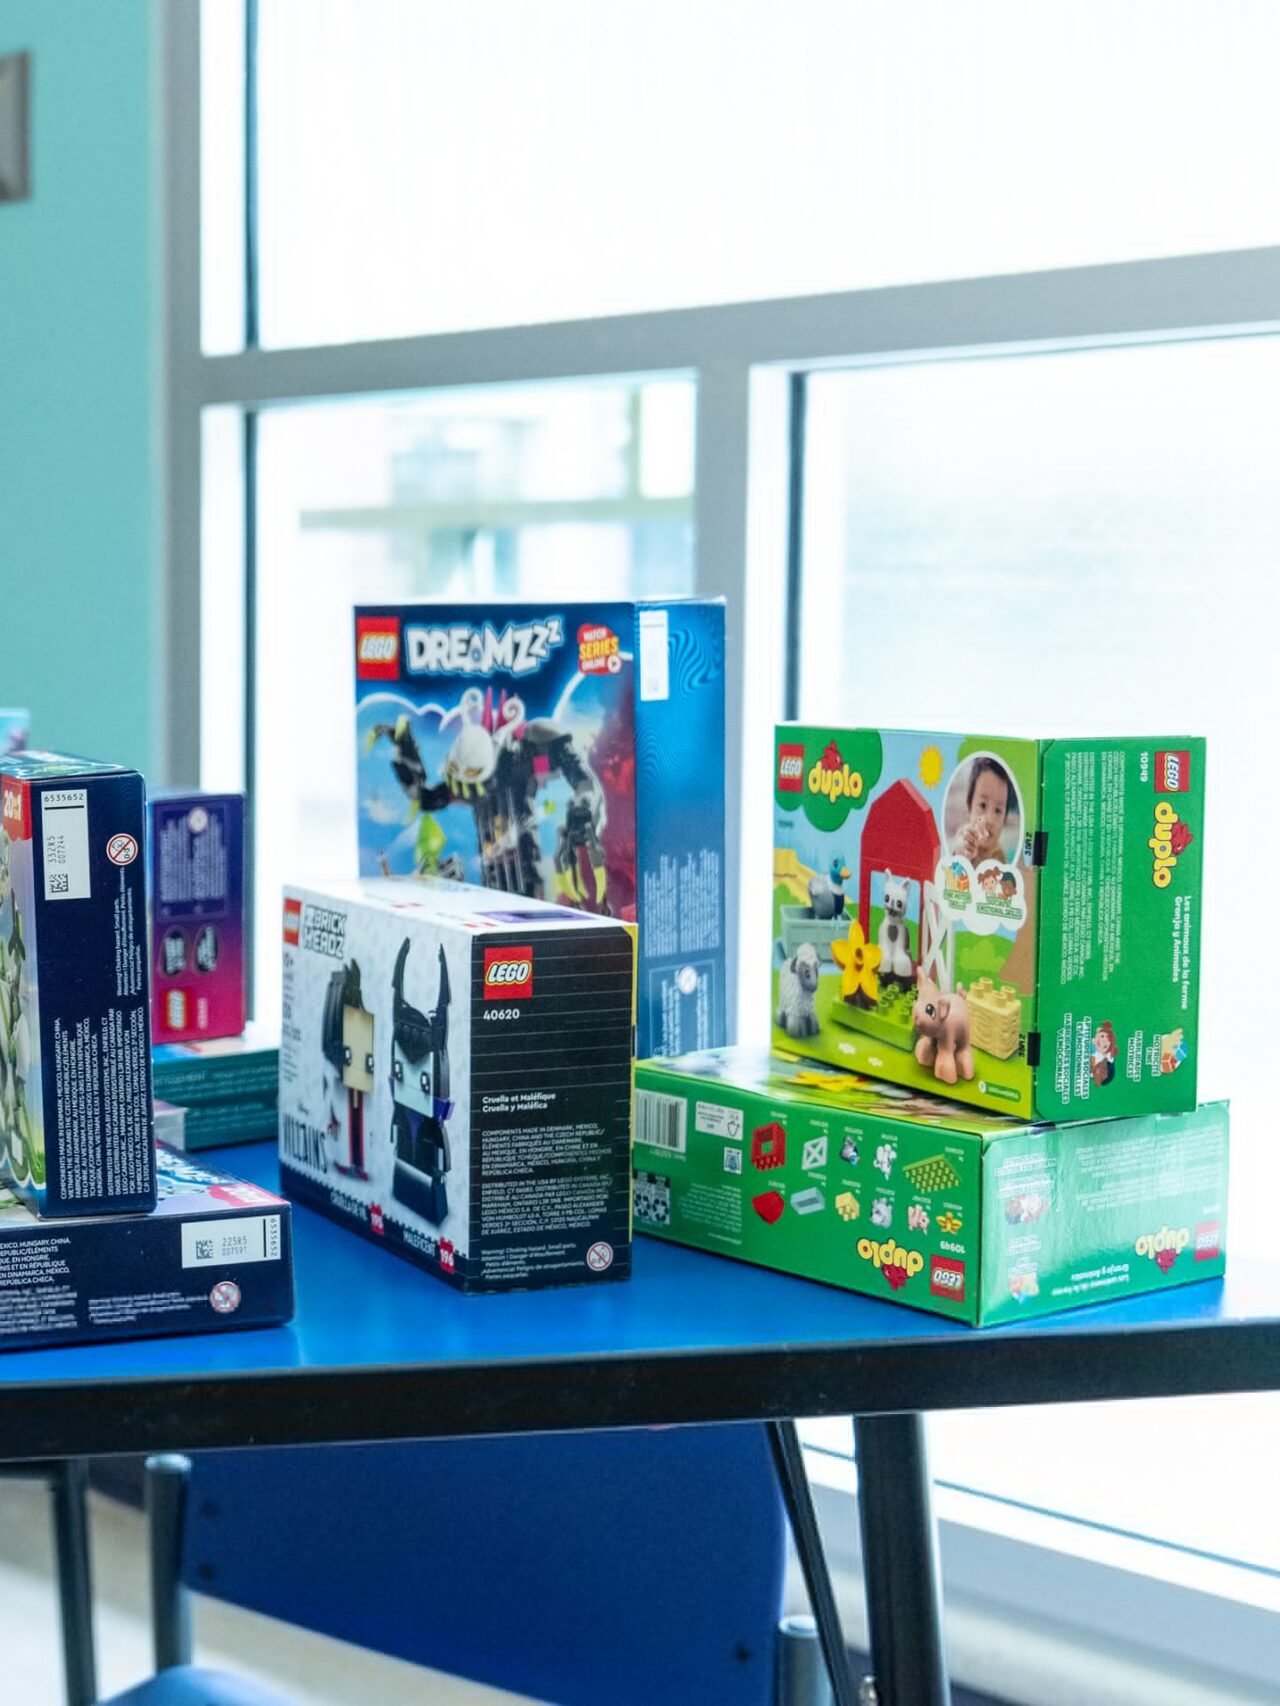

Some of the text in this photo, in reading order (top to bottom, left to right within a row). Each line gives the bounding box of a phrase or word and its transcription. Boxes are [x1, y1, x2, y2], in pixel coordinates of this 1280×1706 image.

[359, 634, 397, 662] LEGO
[579, 637, 619, 660] SERIES
[1140, 752, 1148, 782] 10949
[808, 760, 863, 804] duplo
[44, 792, 85, 803] 6535652
[1148, 753, 1180, 889] LEGO duplo
[1172, 896, 1182, 928] Granja
[1183, 913, 1191, 954] animaux
[485, 960, 532, 985] LEGO
[1172, 939, 1181, 982] Animales
[1182, 956, 1190, 967] de
[1182, 969, 1189, 978] la
[1181, 980, 1189, 1009] ferme
[483, 1008, 520, 1021] 40620
[482, 1091, 555, 1104] Cruella et Maléfique
[482, 1100, 547, 1113] Cruella y Maléfica
[270, 1218, 279, 1258] 6535652
[939, 1240, 966, 1255] 10949
[1134, 1225, 1190, 1260] duplo
[440, 1249, 454, 1267] 196
[856, 1237, 963, 1289] LEGO duplo
